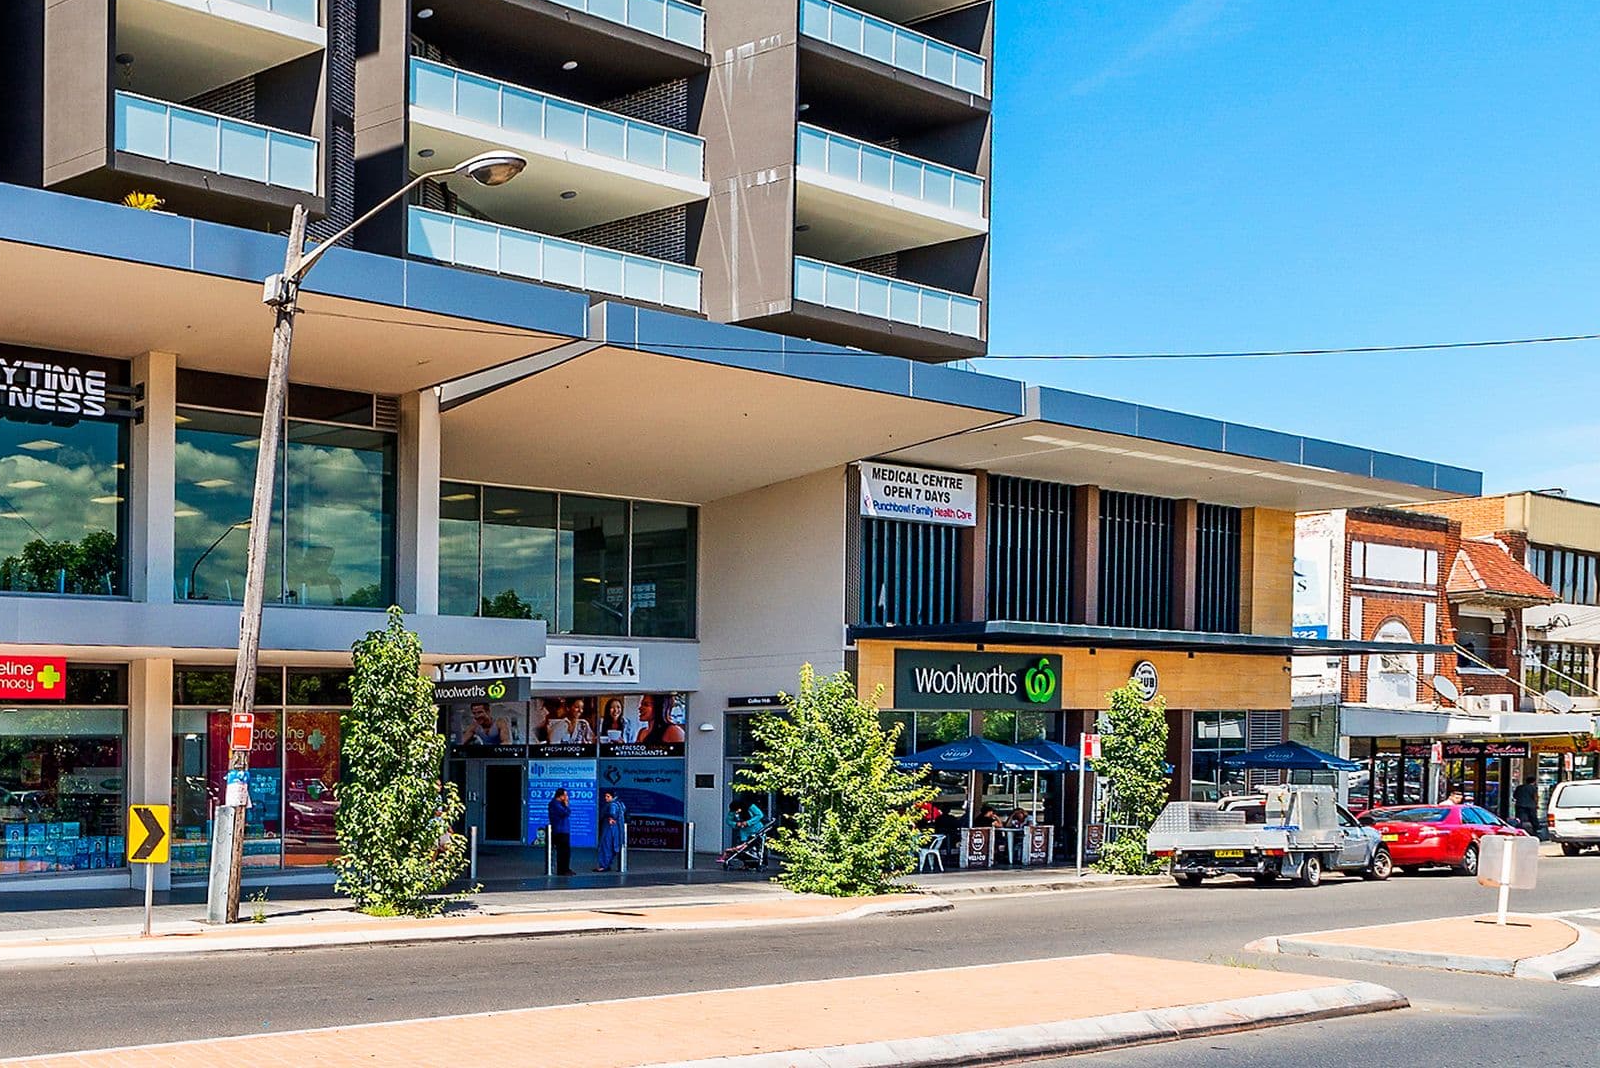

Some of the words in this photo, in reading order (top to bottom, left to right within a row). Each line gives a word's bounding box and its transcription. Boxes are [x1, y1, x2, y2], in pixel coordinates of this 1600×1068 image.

[872, 467, 919, 485] MEDICAL
[922, 474, 963, 490] CENTRE
[884, 485, 912, 499] OPEN
[915, 488, 922, 500] 7
[925, 490, 951, 503] DAYS
[873, 500, 911, 512] Punchbowl
[912, 504, 934, 518] Family
[934, 507, 955, 518] Health
[956, 509, 972, 520] Care
[563, 652, 636, 676] PLAZA
[915, 664, 1017, 695] Woolworths
[435, 684, 486, 698] Woolworths
[530, 790, 542, 799] 02
[569, 790, 594, 799] 3700
